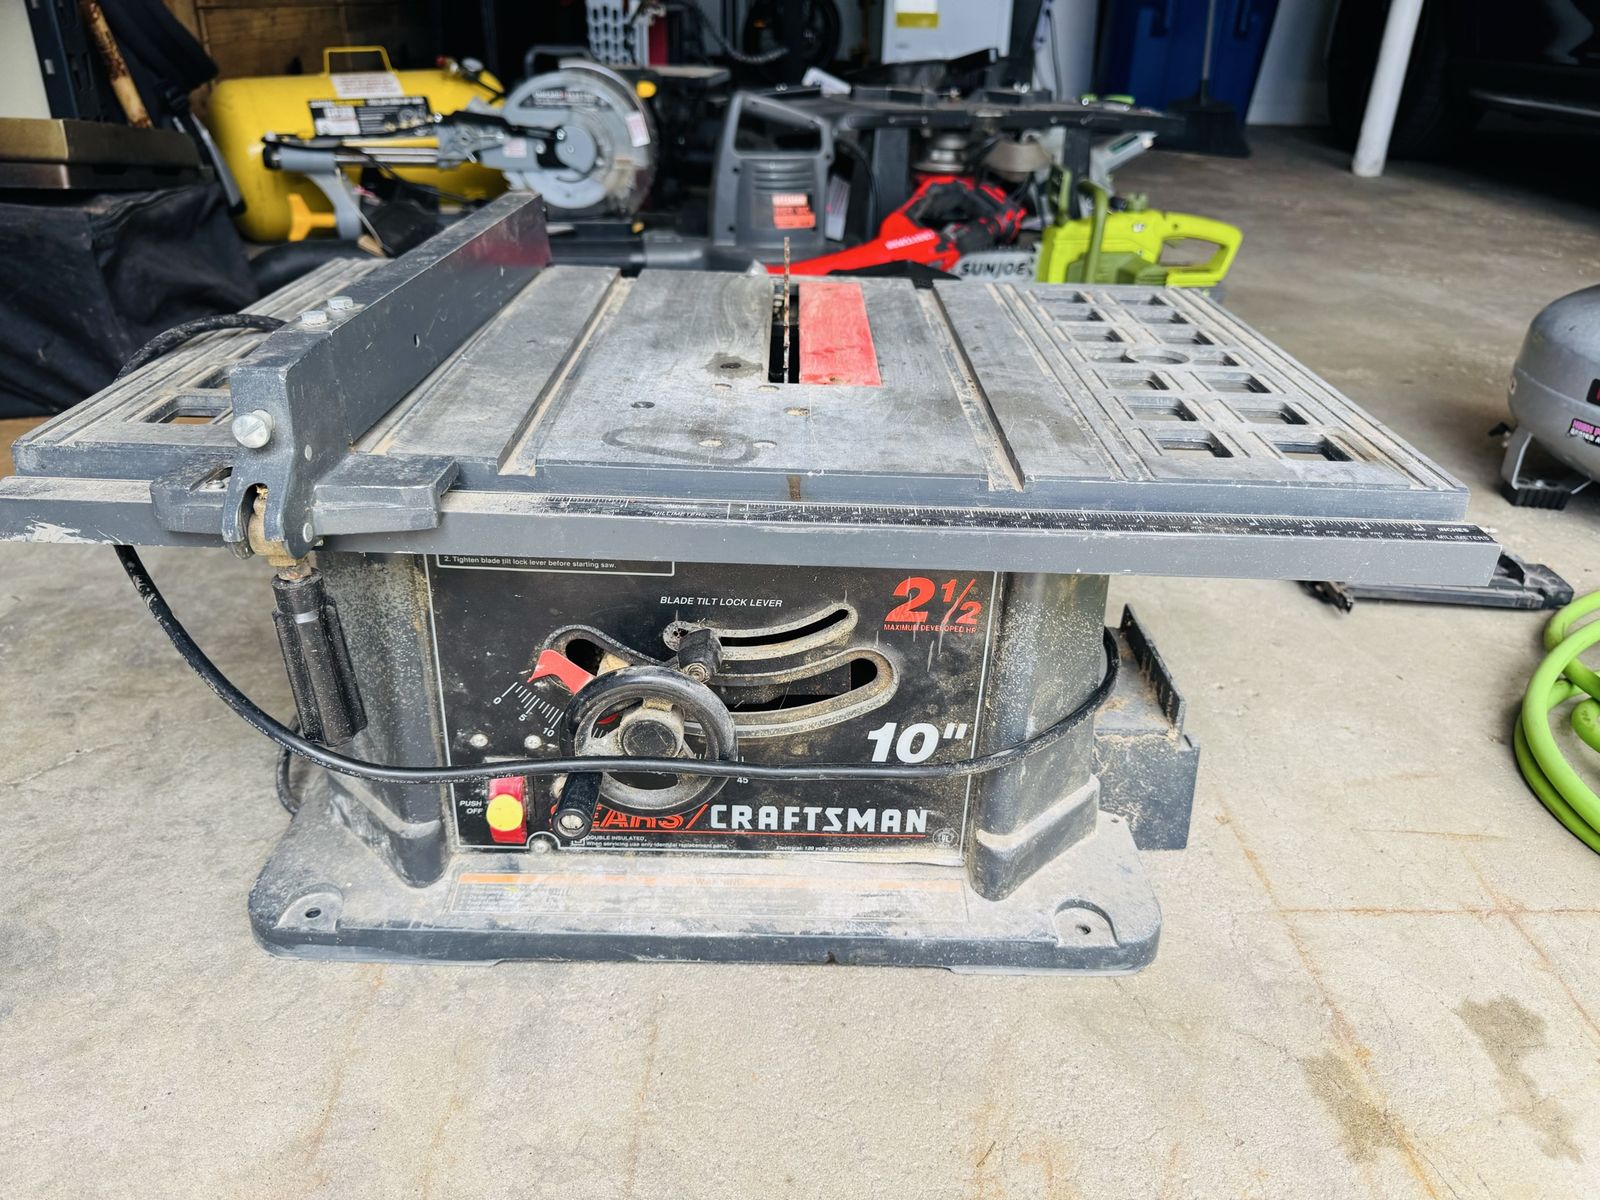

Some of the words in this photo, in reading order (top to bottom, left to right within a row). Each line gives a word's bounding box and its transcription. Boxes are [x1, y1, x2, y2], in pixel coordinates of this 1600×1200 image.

[453, 556, 480, 564] Tighten
[573, 560, 599, 569] starting
[660, 596, 694, 605] BLADE
[697, 597, 718, 606] TILT
[720, 598, 748, 607] LOCK
[750, 598, 783, 607] LEVER
[884, 576, 937, 623] 2
[884, 624, 920, 632] MAXIMUM
[920, 624, 964, 633] DEVELOPED
[492, 696, 502, 705] 0
[518, 713, 528, 722] 5
[542, 727, 555, 737] 10
[736, 776, 749, 784] 45
[710, 804, 928, 833] CRAFTSMAN
